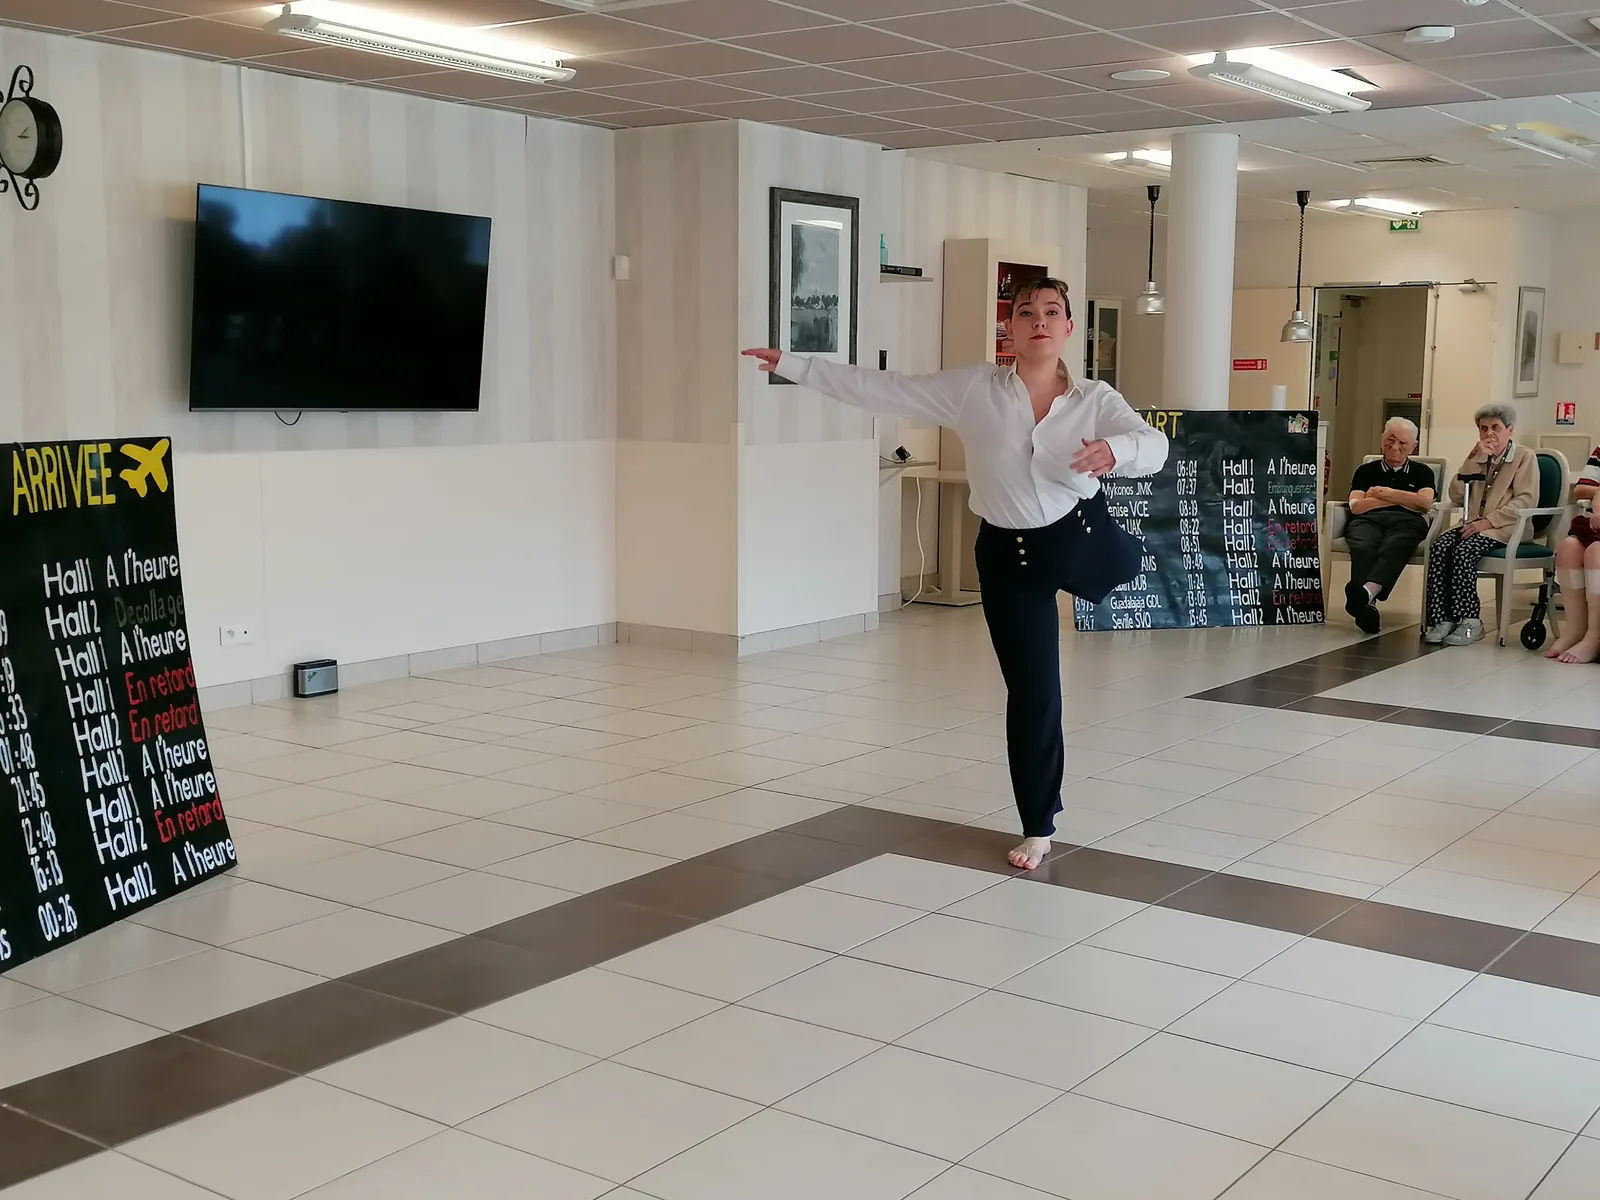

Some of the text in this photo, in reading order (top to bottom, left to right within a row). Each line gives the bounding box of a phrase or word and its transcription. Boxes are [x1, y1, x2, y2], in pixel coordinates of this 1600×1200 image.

[1146, 411, 1183, 439] ART
[13, 443, 116, 516] ARRIVEE
[1176, 460, 1197, 477] 06:04
[1267, 458, 1275, 475] A
[1280, 456, 1316, 475] l'heure
[1102, 482, 1133, 499] Mykonos
[1136, 482, 1153, 496] JMK
[1176, 478, 1197, 495] 07:37
[1106, 501, 1129, 517] enise
[1129, 500, 1149, 517] VCE
[1268, 498, 1277, 515] A
[1279, 496, 1315, 515] l'heure
[106, 555, 119, 588] A
[124, 548, 179, 585] l'heure
[1272, 552, 1280, 568] A
[1284, 550, 1320, 569] l'heure
[1273, 573, 1282, 589] A
[1285, 571, 1320, 590] l'heure
[1276, 608, 1285, 624] A
[1286, 605, 1323, 623] l'heure
[121, 631, 134, 665] A
[133, 624, 187, 662] l'heure
[125, 671, 148, 706] En
[151, 657, 196, 699] retard
[128, 709, 151, 743] En
[155, 696, 198, 735] retard
[11, 771, 46, 813] 21:45
[142, 744, 154, 777] A
[155, 734, 207, 772] l'heure
[21, 810, 57, 855] 12:48
[150, 777, 165, 810] A
[164, 768, 216, 805] l'heure
[154, 810, 177, 843] En
[178, 792, 223, 835] retard
[38, 894, 78, 942] 00:26
[172, 852, 187, 885] A
[184, 838, 236, 878] l'heure
